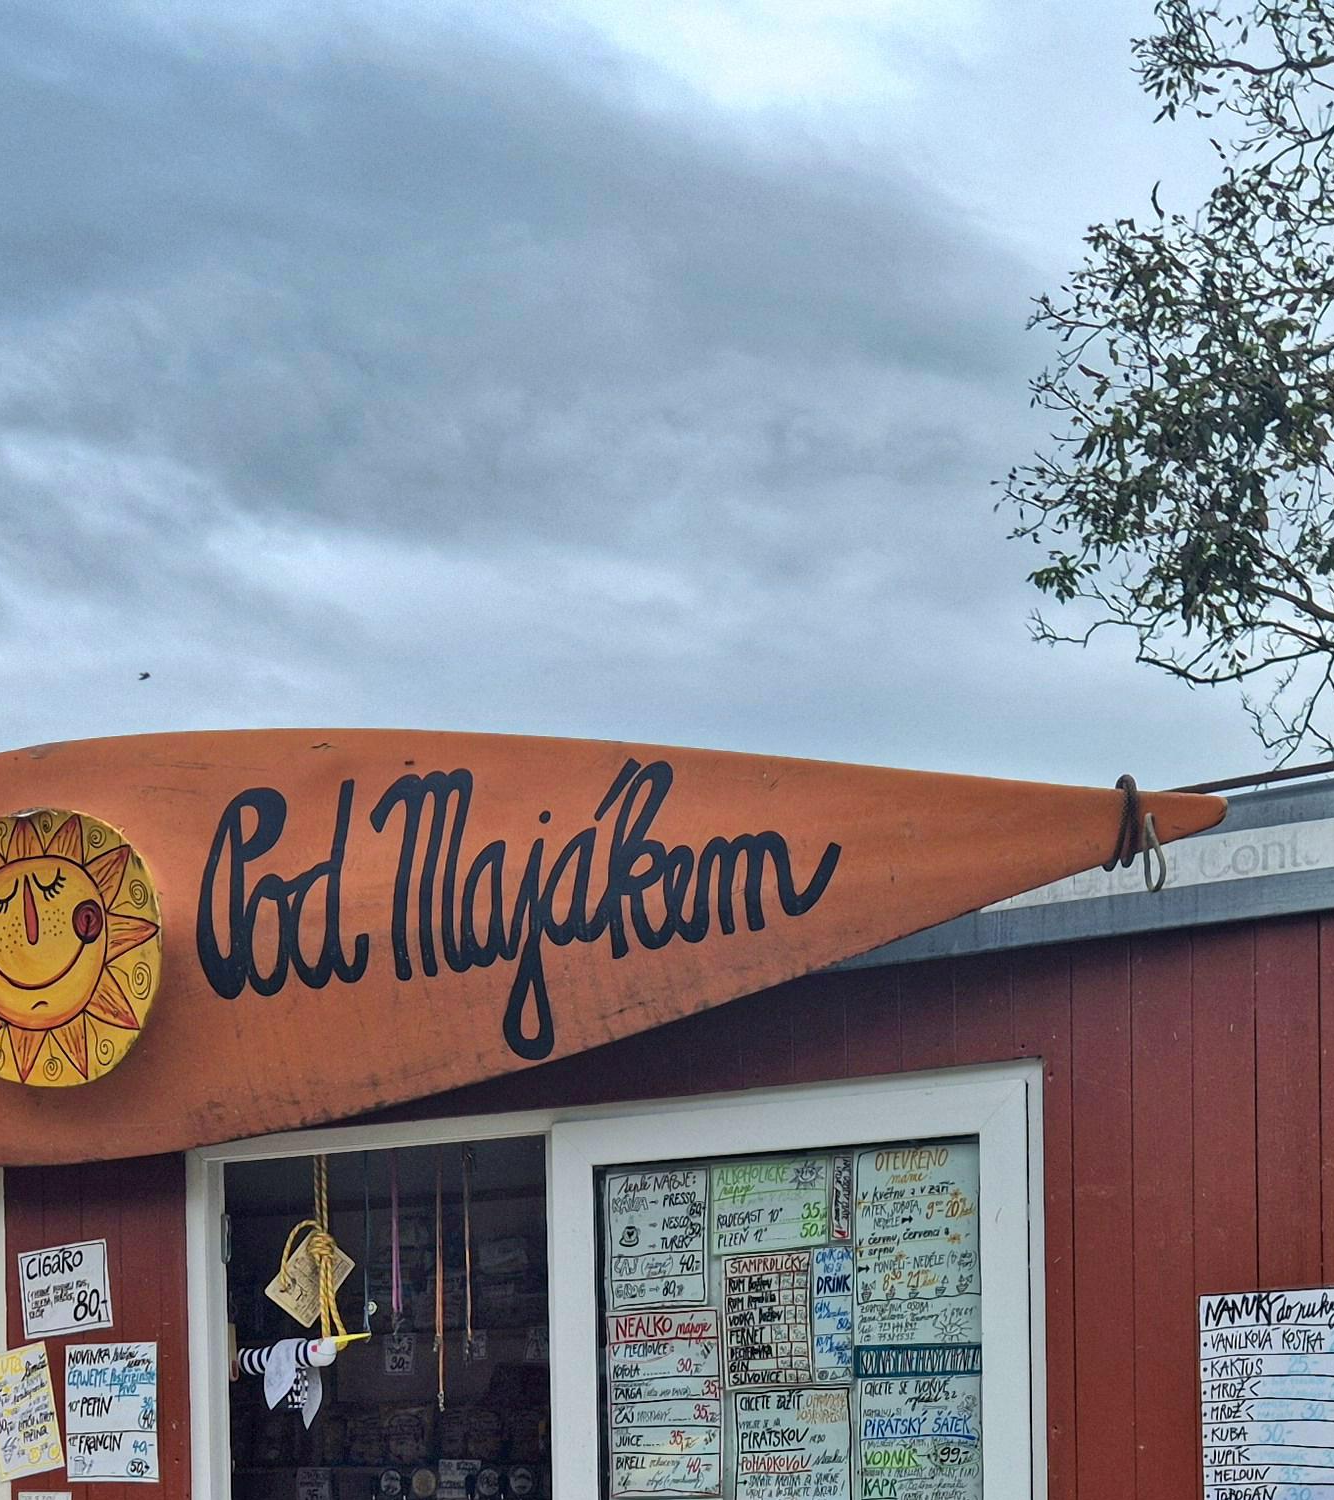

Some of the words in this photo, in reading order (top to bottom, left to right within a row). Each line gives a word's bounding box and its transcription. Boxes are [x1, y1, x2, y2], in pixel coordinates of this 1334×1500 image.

[197, 778, 369, 1000] Pod
[369, 758, 841, 1060] Majákem
[875, 1147, 948, 1172] OTEVŘENO
[663, 1192, 696, 1207] PRESSO
[1205, 1292, 1285, 1327] NANUKY
[616, 1316, 673, 1339] NEALKO
[729, 1326, 765, 1346] FERNET
[1211, 1327, 1281, 1353] VANILKOVÁ
[1210, 1358, 1263, 1378] KAKTUS
[1210, 1377, 1251, 1399] MROŽ
[1210, 1400, 1246, 1420] MROŽ
[864, 1410, 928, 1438] PIRÁTSKÝ
[932, 1410, 972, 1434] ŠÁTEK
[1211, 1427, 1248, 1442] KUBA
[1213, 1466, 1270, 1484] MELOUN
[864, 1478, 898, 1497] KAPR
